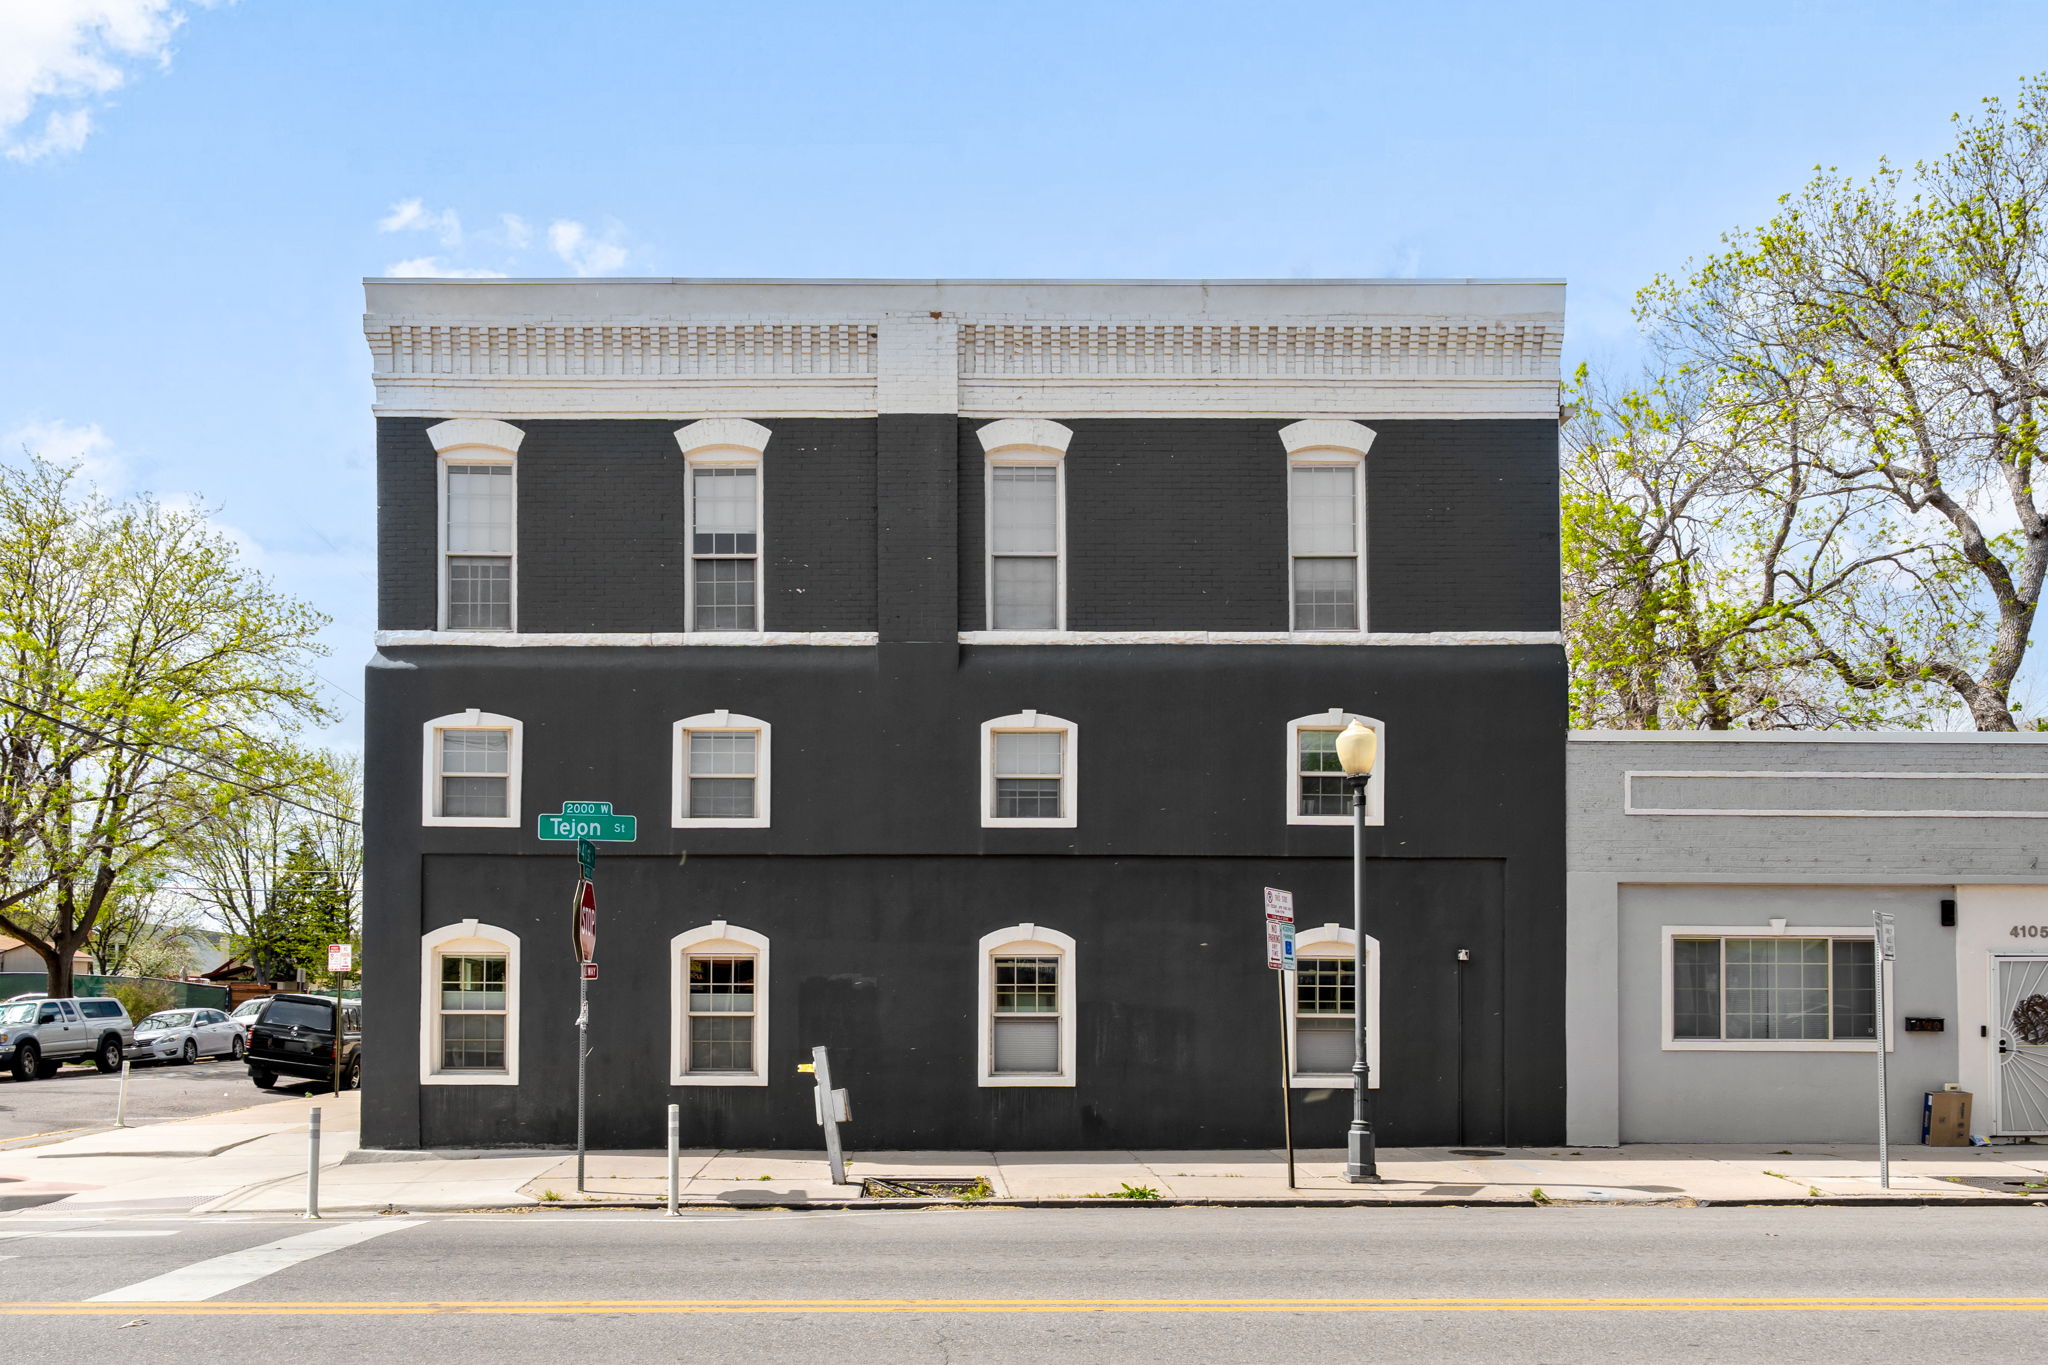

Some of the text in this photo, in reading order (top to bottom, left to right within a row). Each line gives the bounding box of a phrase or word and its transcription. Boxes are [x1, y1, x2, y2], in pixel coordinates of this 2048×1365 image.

[566, 804, 609, 813] 2000 W
[550, 818, 625, 838] Tejon St
[581, 906, 595, 936] STOP
[2009, 925, 2048, 938] 4105
